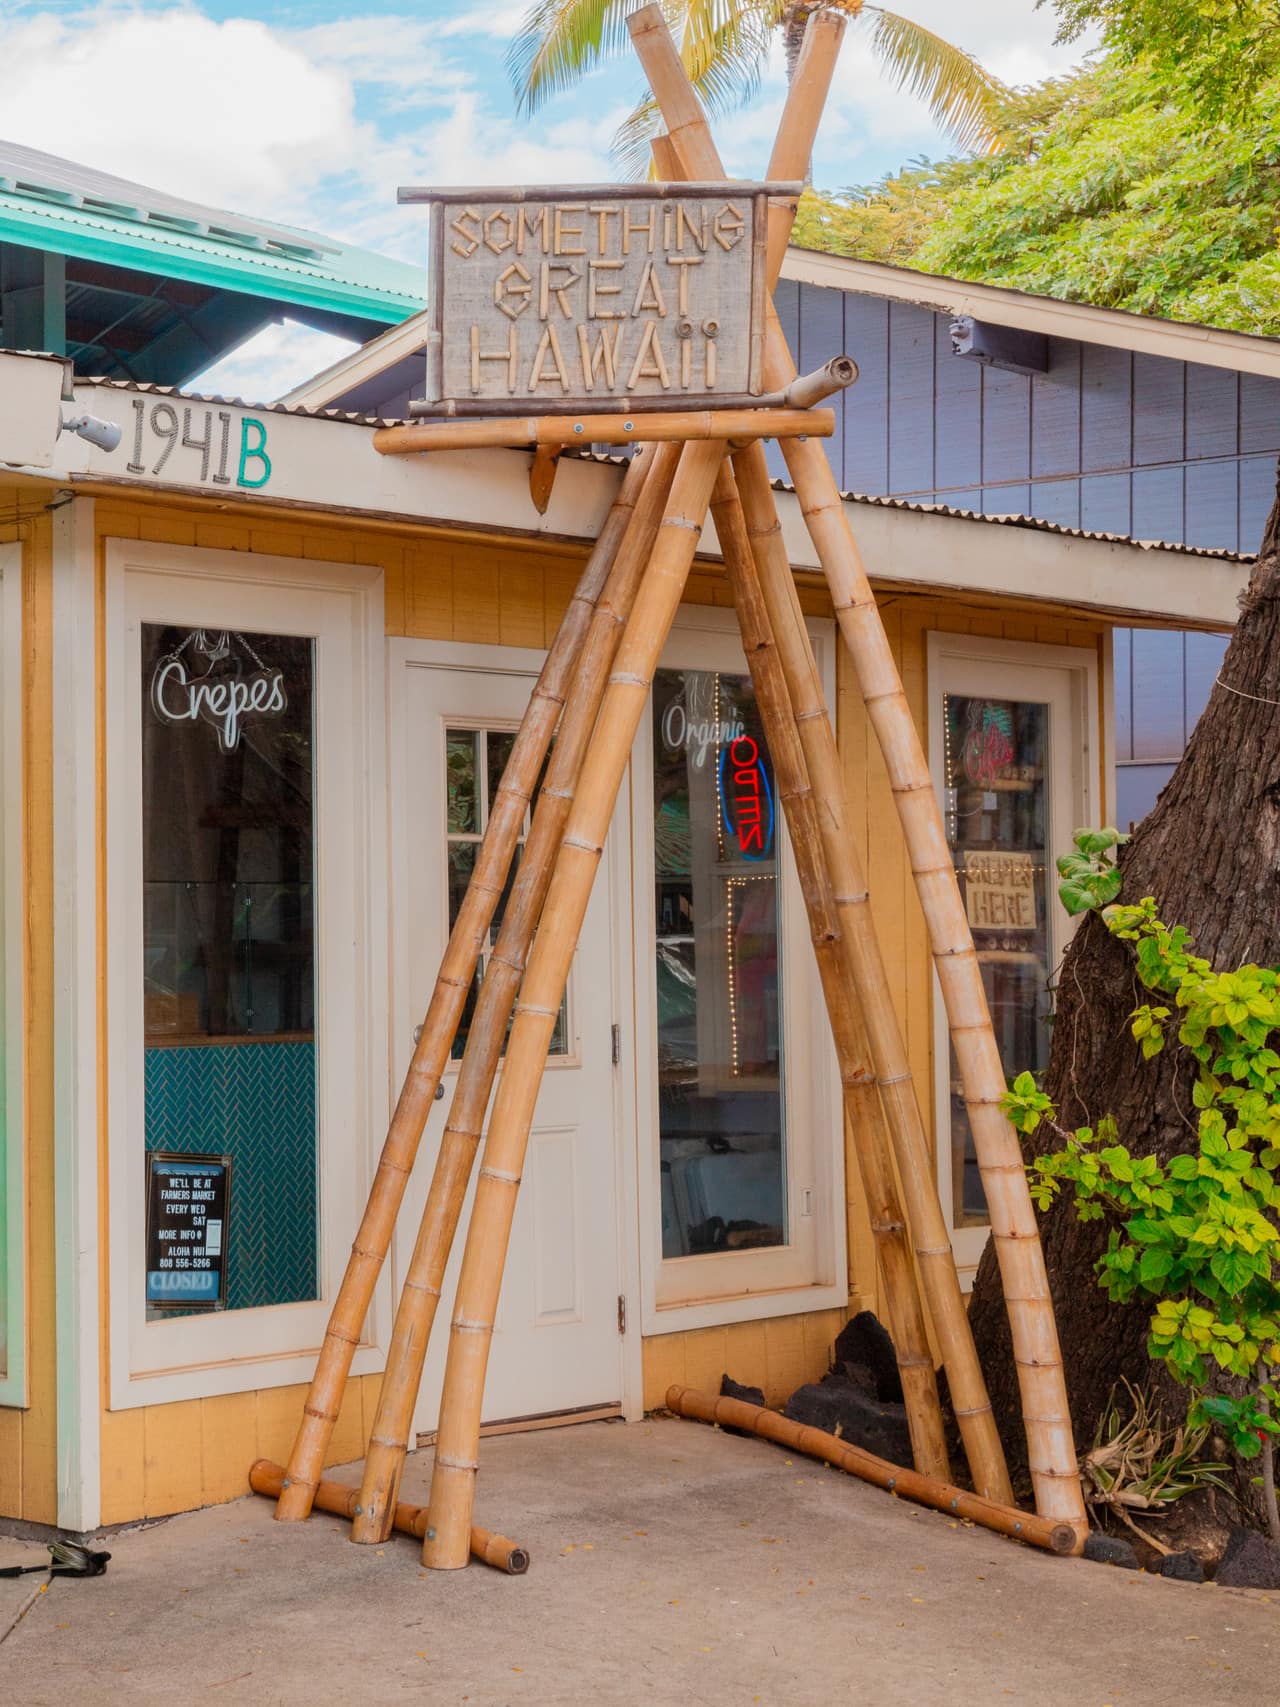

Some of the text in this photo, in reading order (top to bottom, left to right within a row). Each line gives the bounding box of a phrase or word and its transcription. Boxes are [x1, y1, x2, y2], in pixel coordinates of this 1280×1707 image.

[493, 256, 705, 322] GREAT
[126, 398, 272, 489] 1941B
[157, 661, 285, 749] Crepes
[666, 705, 745, 768] Organic
[193, 1178, 202, 1189] BE
[204, 1178, 213, 1189] AT
[161, 1189, 216, 1201] FARMERS MARKET
[166, 1203, 206, 1214] EVERY WED
[192, 1216, 206, 1226] SAT
[158, 1229, 177, 1240] MORE
[168, 1246, 190, 1256] ALOHA
[160, 1258, 173, 1268] 808
[150, 1272, 213, 1291] CLOSED
